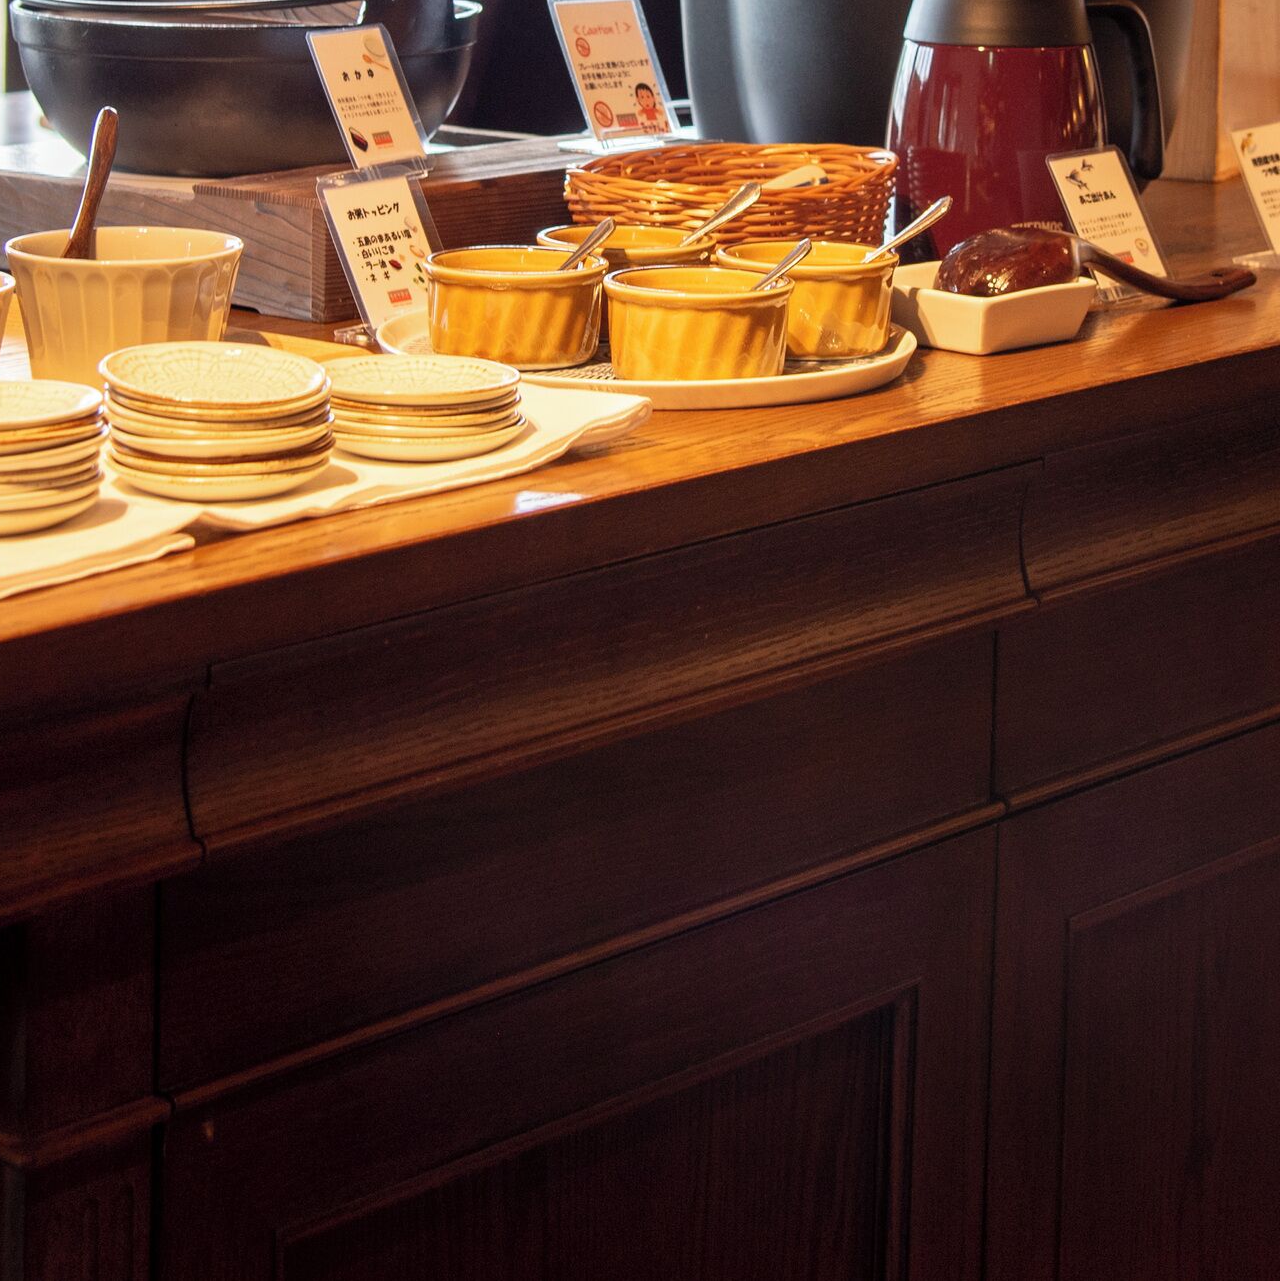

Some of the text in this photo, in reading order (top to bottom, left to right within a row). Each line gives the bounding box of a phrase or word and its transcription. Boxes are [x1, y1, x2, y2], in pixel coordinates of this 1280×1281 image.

[347, 202, 400, 221] お粥トッピング
